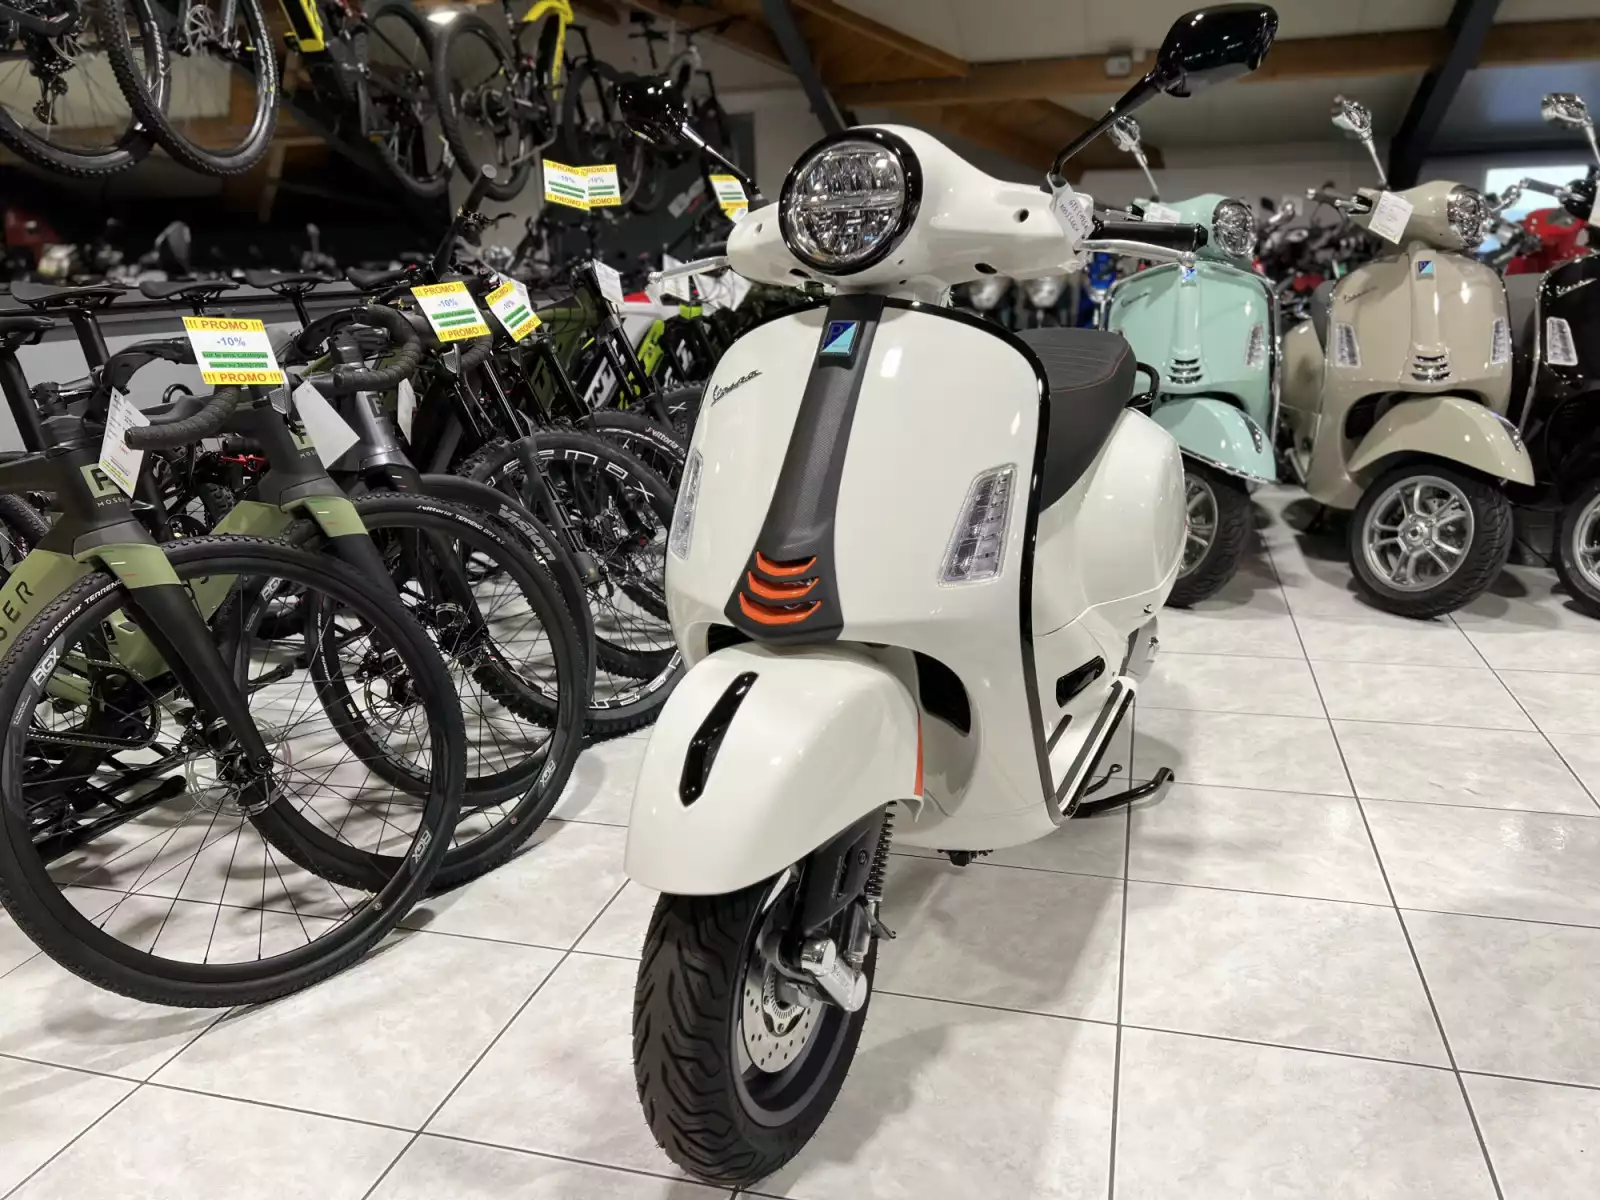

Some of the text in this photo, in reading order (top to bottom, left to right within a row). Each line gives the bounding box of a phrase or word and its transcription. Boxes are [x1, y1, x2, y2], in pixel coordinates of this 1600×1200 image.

[150, 20, 165, 76] PIRELLI
[423, 285, 455, 296] PROMO
[438, 298, 458, 307] -10%
[201, 320, 248, 330] PROMO
[448, 328, 479, 338] PROMO
[217, 337, 246, 347] -10%
[220, 374, 267, 382] PROMO
[422, 505, 452, 516] vittoria
[455, 514, 483, 531] TERRENO
[47, 603, 82, 639] vittoria
